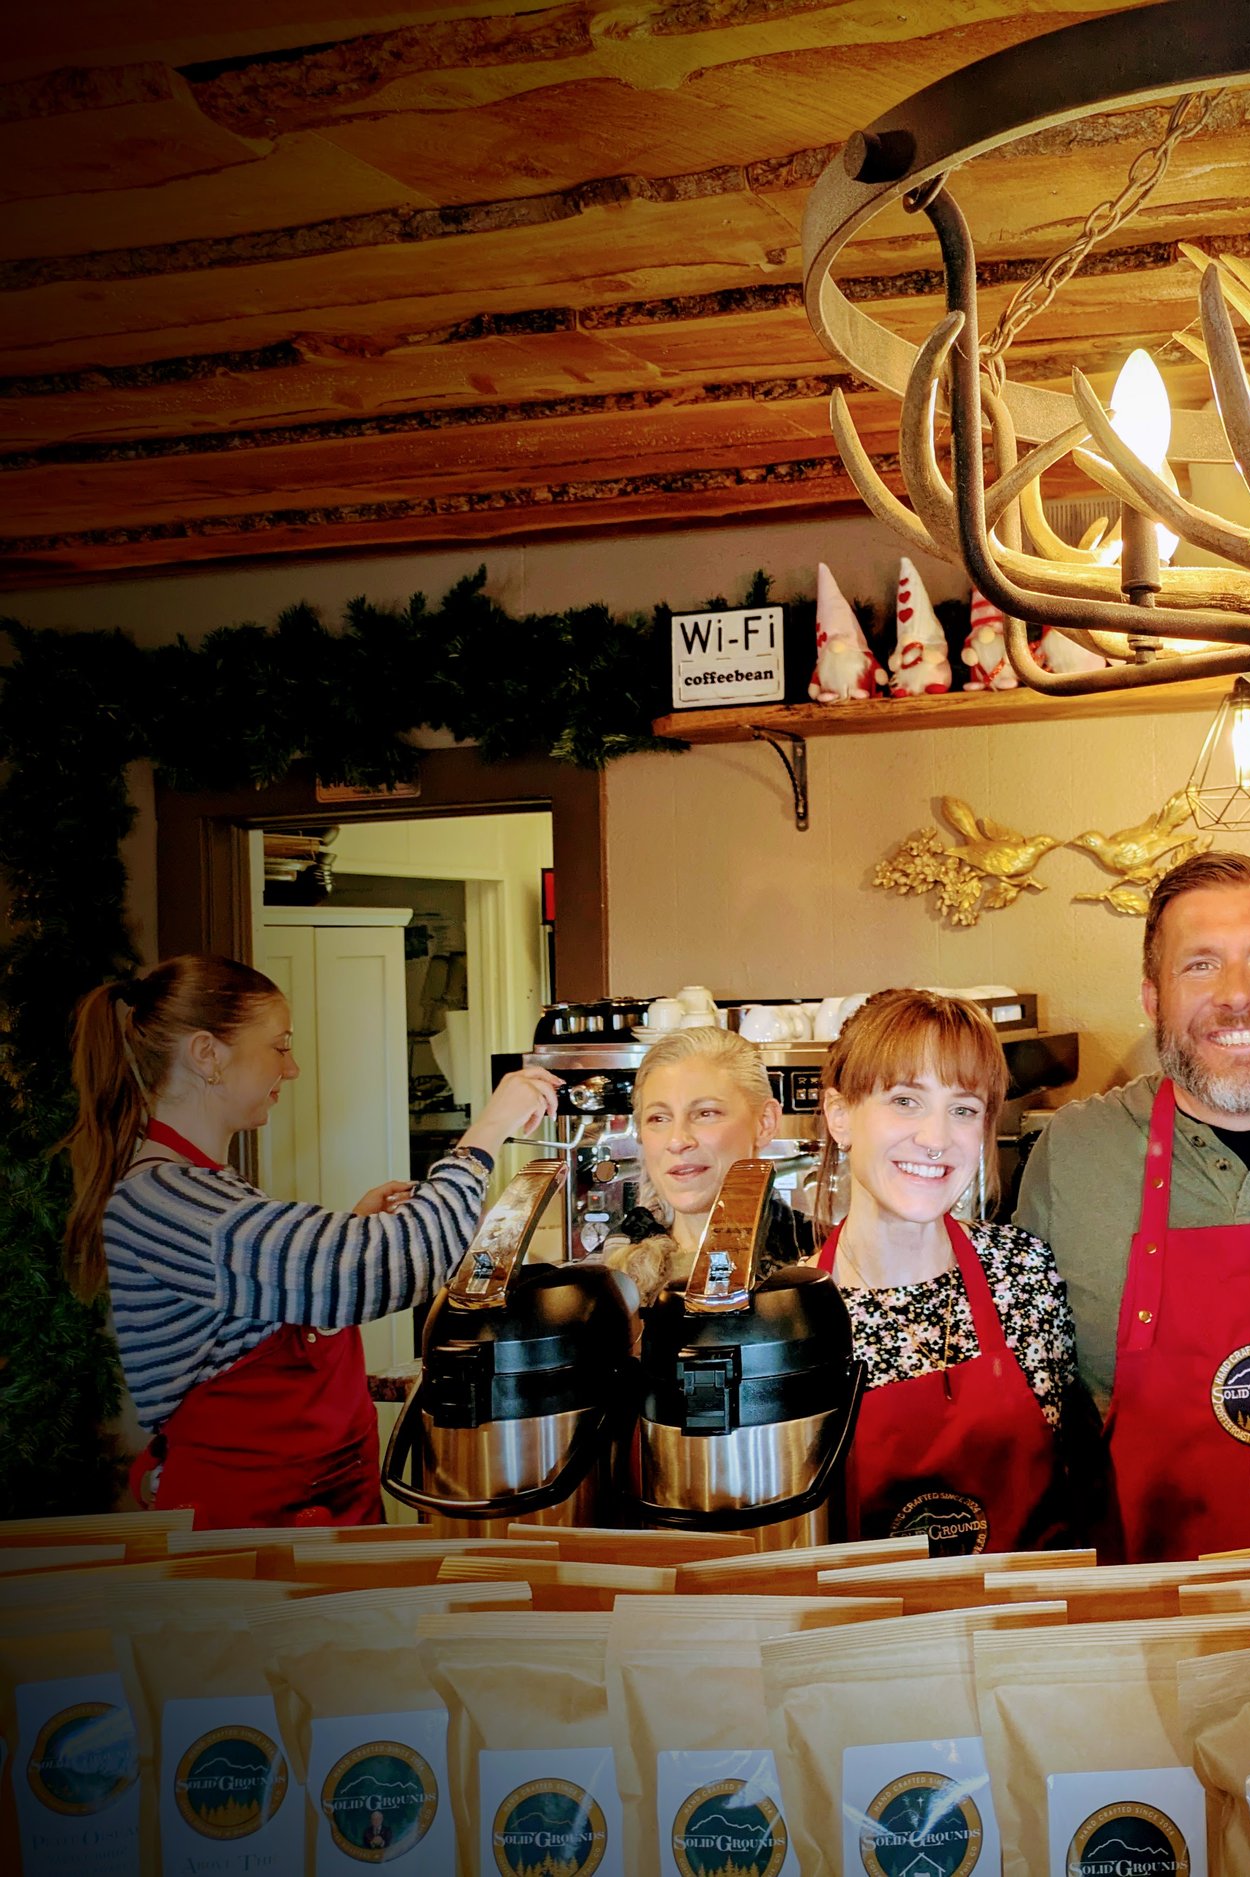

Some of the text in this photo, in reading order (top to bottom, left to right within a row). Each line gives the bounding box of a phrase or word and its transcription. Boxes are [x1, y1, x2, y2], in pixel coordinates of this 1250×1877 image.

[680, 614, 775, 655] Wi-Fi
[684, 669, 774, 686] coffeebean
[1215, 1361, 1231, 1384] HAND
[1213, 1385, 1250, 1404] SOLID
[902, 1492, 940, 1513] CRAFTED
[928, 1520, 988, 1540] GROUNDS
[176, 1775, 286, 1792] SOLID GROUNS
[323, 1793, 437, 1814] SOLID GROUNDS
[493, 1831, 534, 1848] SOLID
[673, 1835, 715, 1851] SOLID
[908, 1828, 981, 1848] GROUNDS
[1069, 1860, 1188, 1877] SOLID GROUNDS
